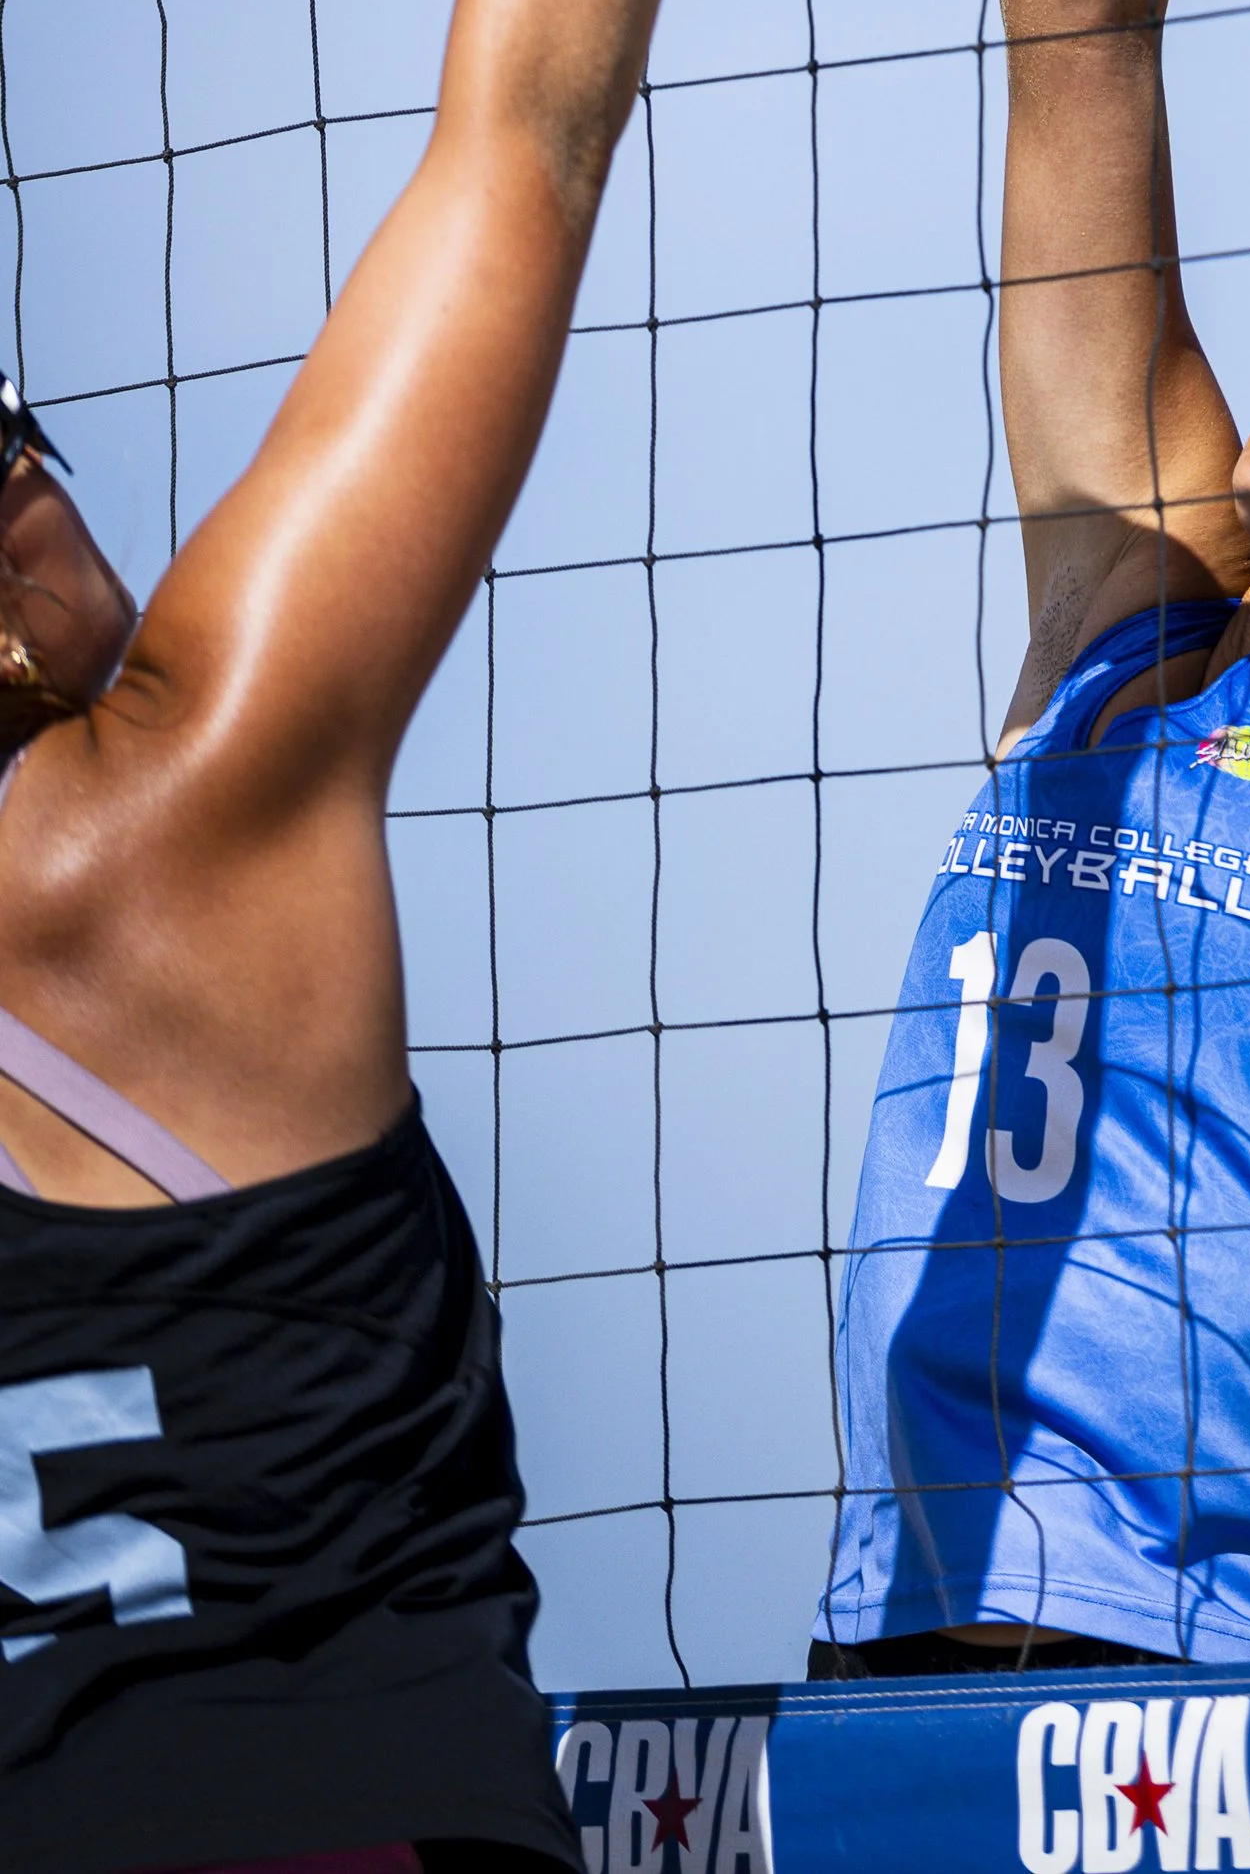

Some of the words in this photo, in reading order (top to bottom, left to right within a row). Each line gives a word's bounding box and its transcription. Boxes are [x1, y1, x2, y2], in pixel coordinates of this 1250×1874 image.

[979, 809, 1077, 842] MONICA
[925, 930, 1091, 1204] 13
[555, 1716, 775, 1874] CBVA
